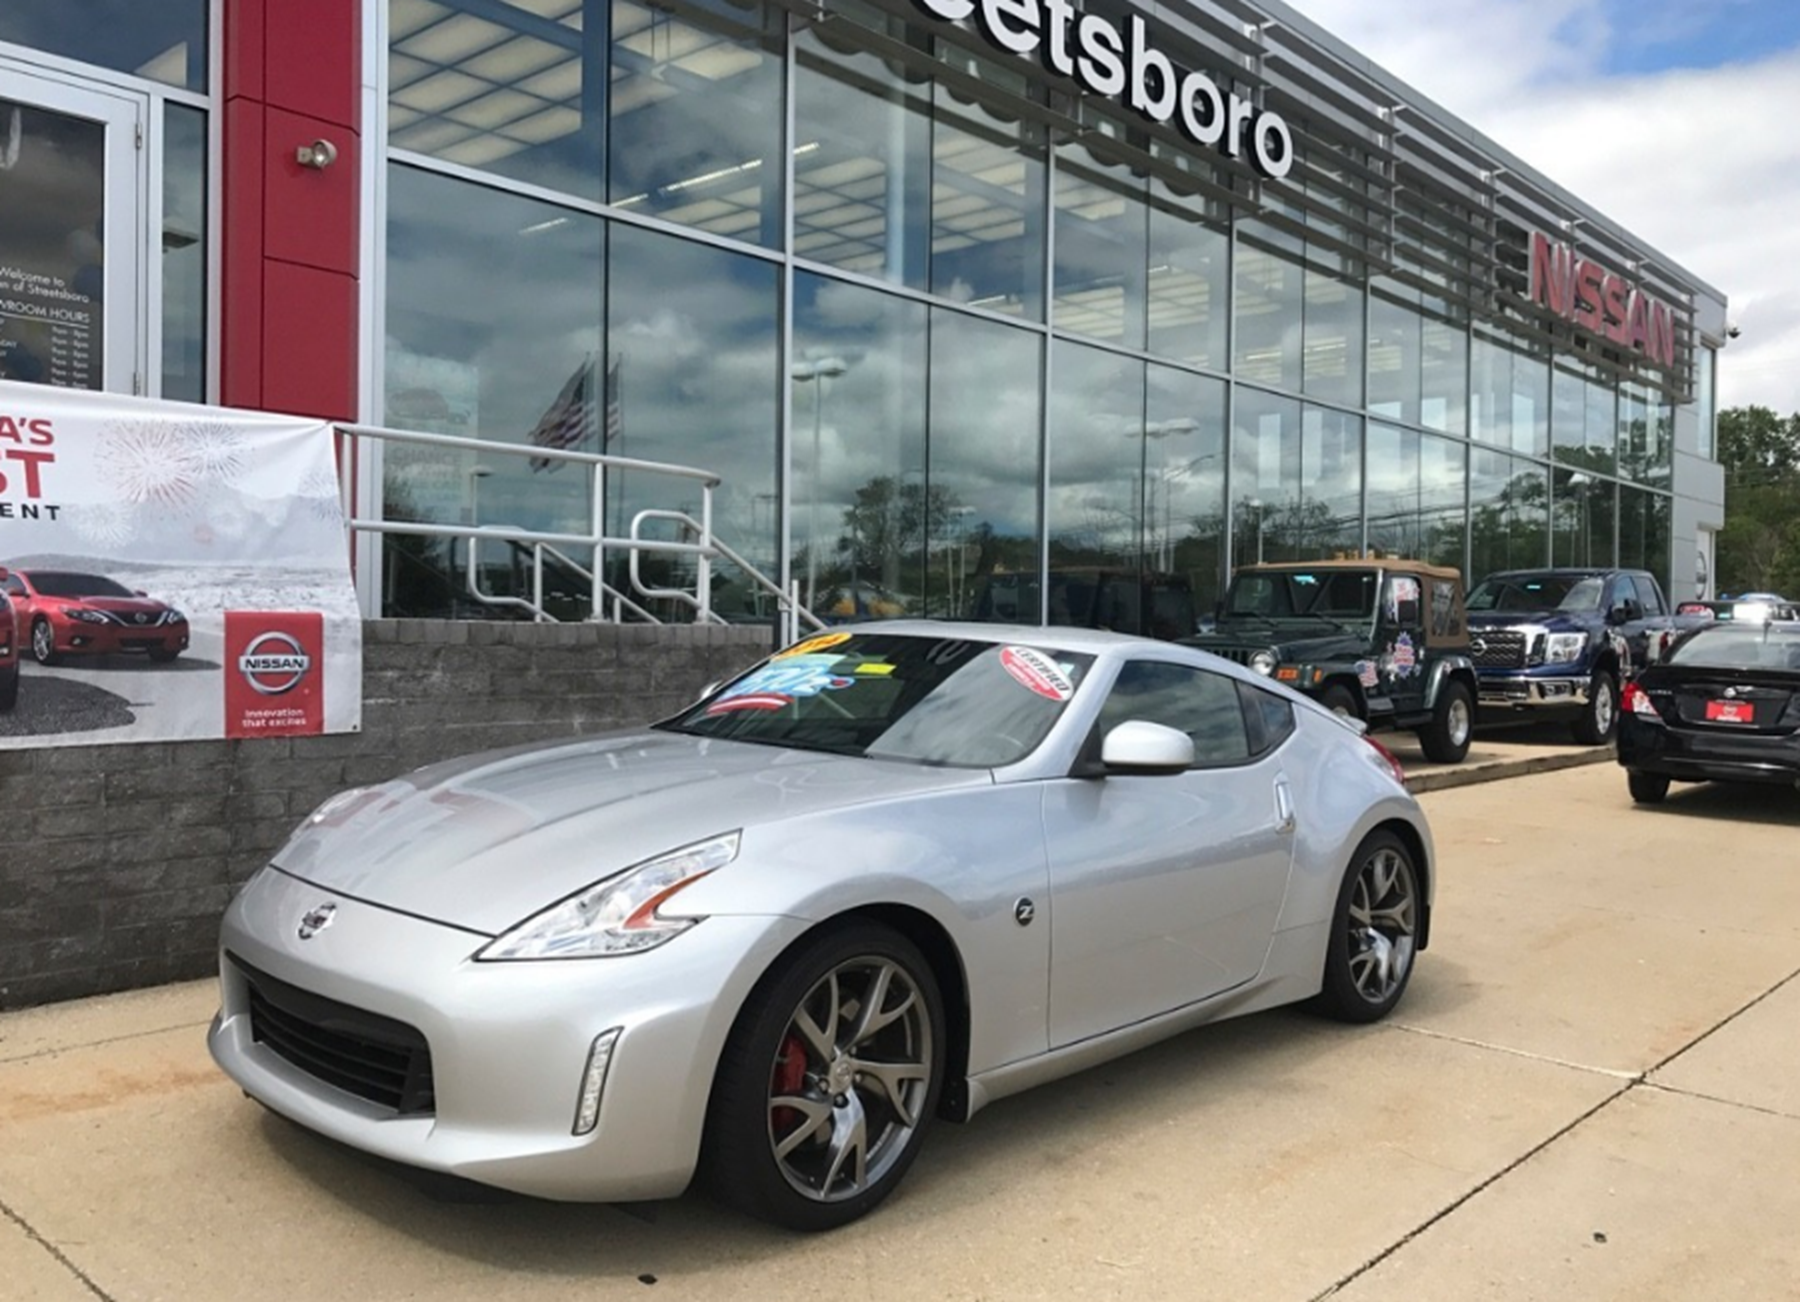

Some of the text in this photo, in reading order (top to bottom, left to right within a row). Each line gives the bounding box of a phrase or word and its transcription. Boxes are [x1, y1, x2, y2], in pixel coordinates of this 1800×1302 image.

[0, 267, 65, 288] Welcome to
[13, 281, 24, 292] of
[27, 283, 89, 304] Streetsboro
[1530, 230, 1674, 368] NISSAN
[49, 307, 90, 323] HOURS
[0, 415, 54, 446] A'S
[0, 502, 60, 521] ENT
[245, 658, 304, 669] NISSAN
[1015, 646, 1070, 691] CERTIFIED
[242, 717, 307, 728] that excites
[245, 707, 304, 719] Innovation
